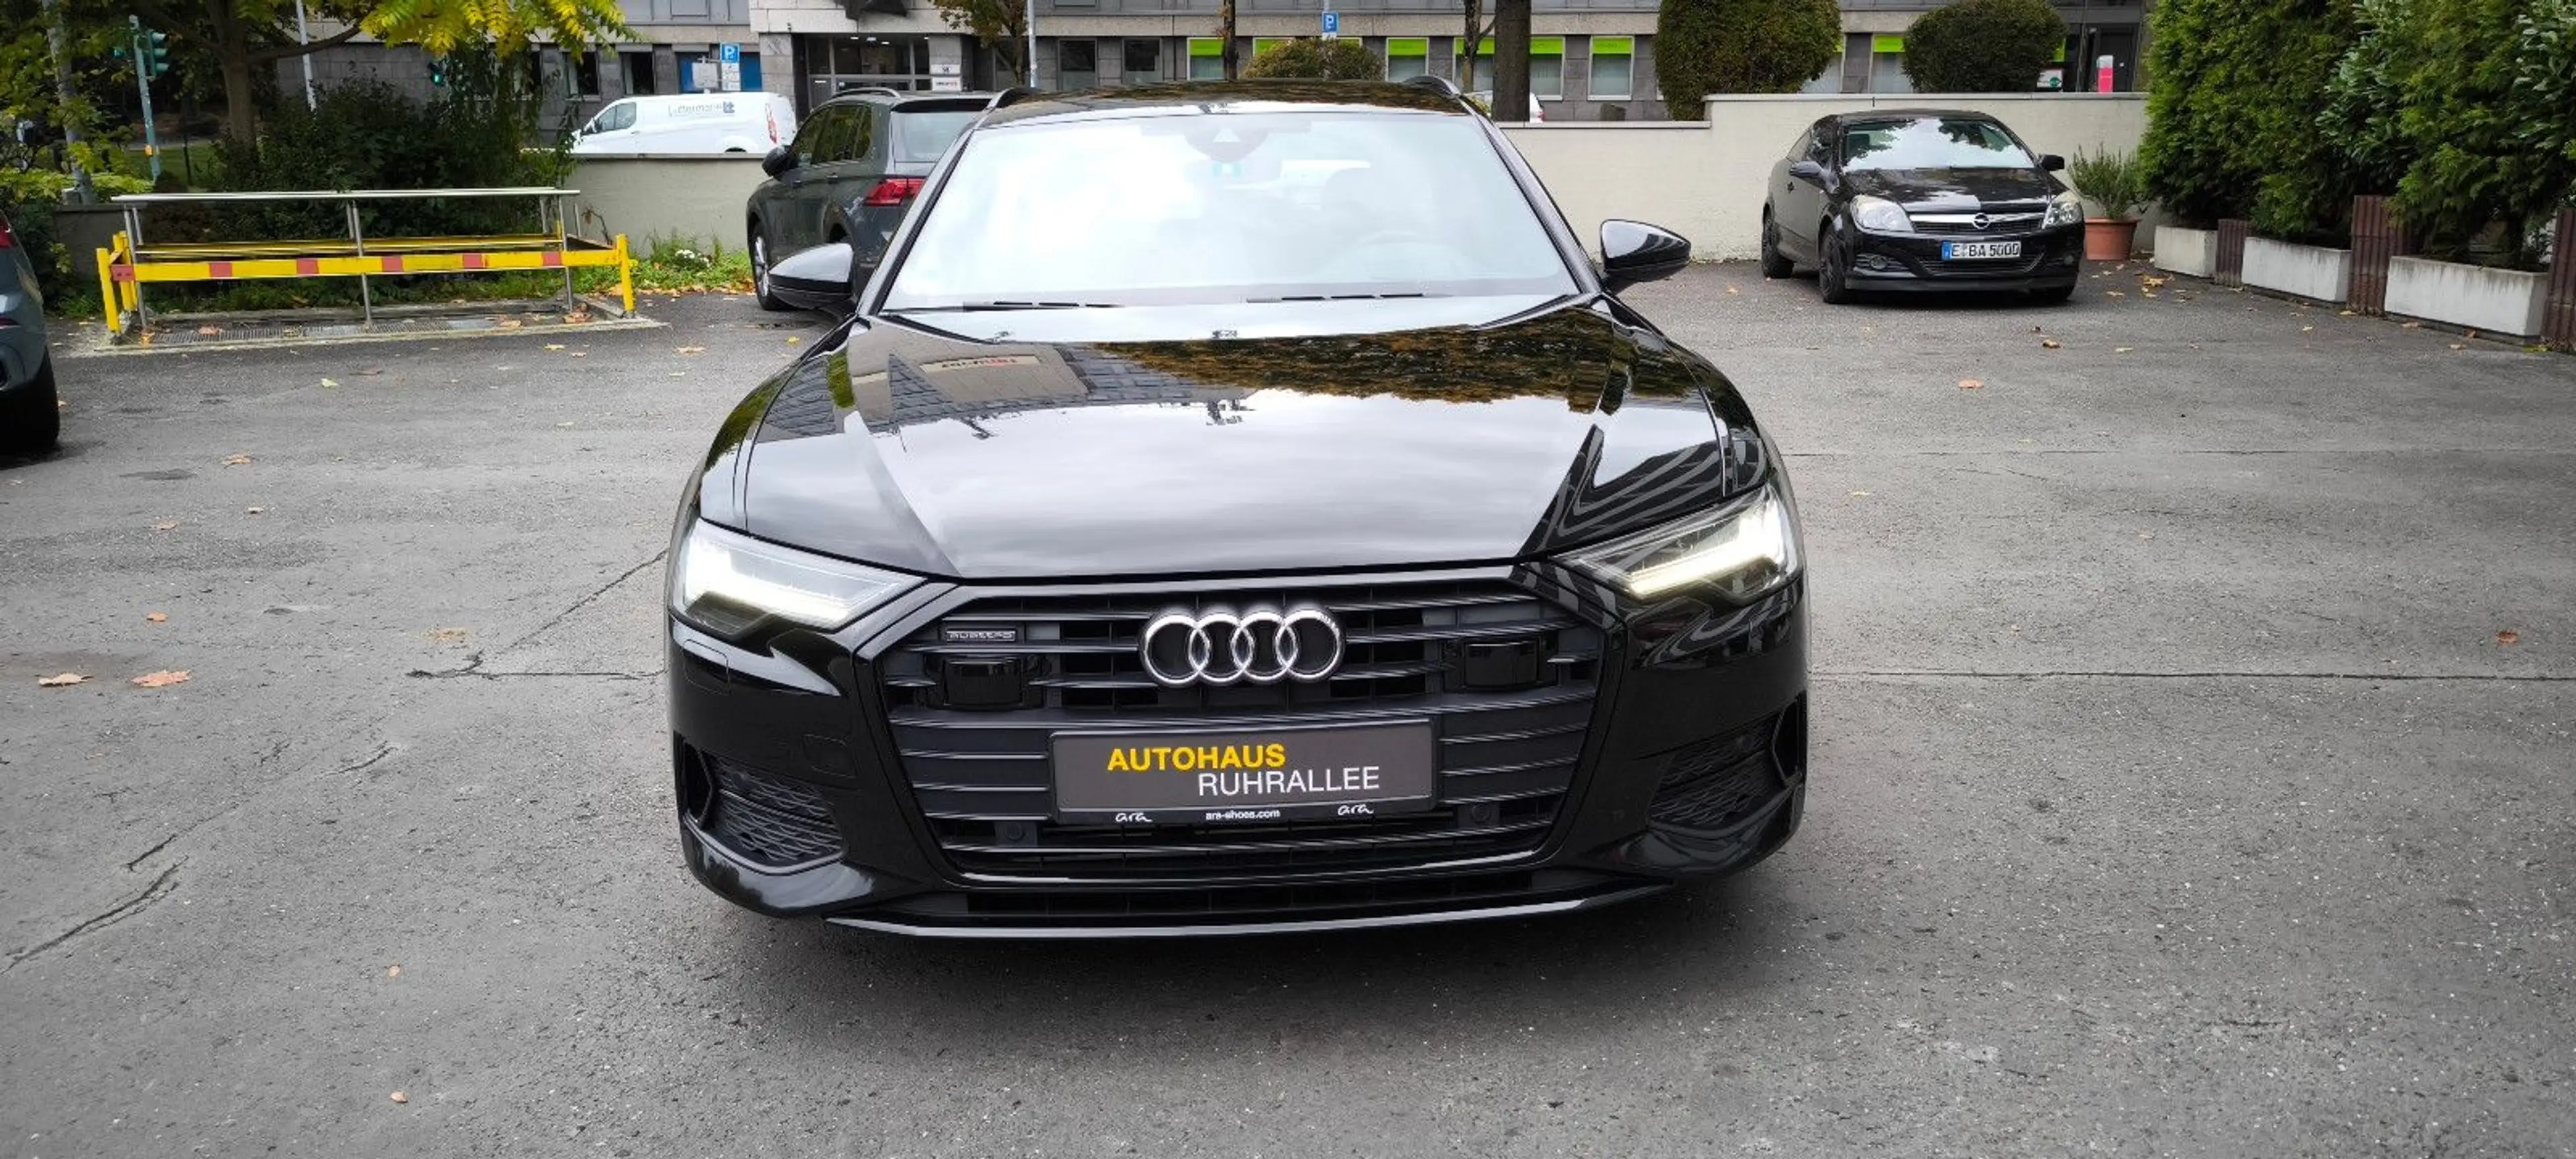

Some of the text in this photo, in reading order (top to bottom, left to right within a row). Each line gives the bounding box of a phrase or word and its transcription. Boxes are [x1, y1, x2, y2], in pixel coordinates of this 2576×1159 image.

[1325, 15, 1334, 30] P
[724, 45, 735, 60] P
[1107, 743, 1286, 771] AUTOHAUS
[1198, 767, 1379, 796] RUHRALLEE
[1115, 812, 1152, 822] ara
[1337, 804, 1374, 816] ara
